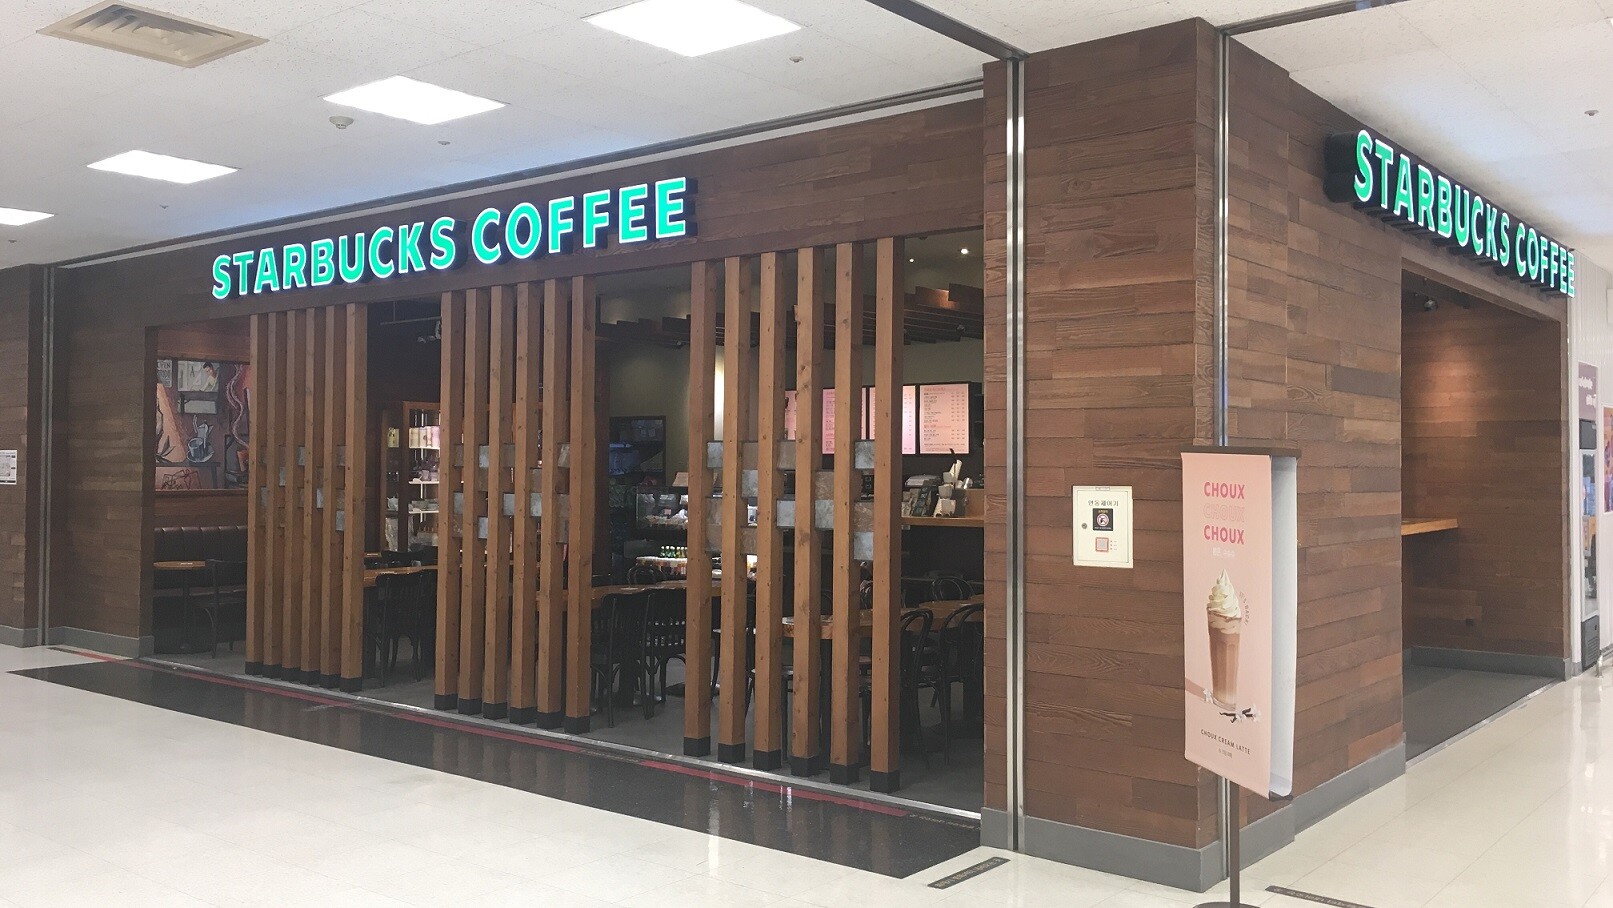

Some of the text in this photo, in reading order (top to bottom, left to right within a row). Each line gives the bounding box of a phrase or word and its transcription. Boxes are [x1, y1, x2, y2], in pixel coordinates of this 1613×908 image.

[1354, 130, 1575, 298] STARBUCKS COFFEE
[211, 177, 687, 299] STARBUCKS COFFEE
[1204, 481, 1245, 499] CHOUX
[1204, 524, 1244, 544] CHOUX
[1201, 729, 1217, 740] CHOUX
[1218, 736, 1235, 748] CREAM
[1236, 744, 1250, 754] LATTE
